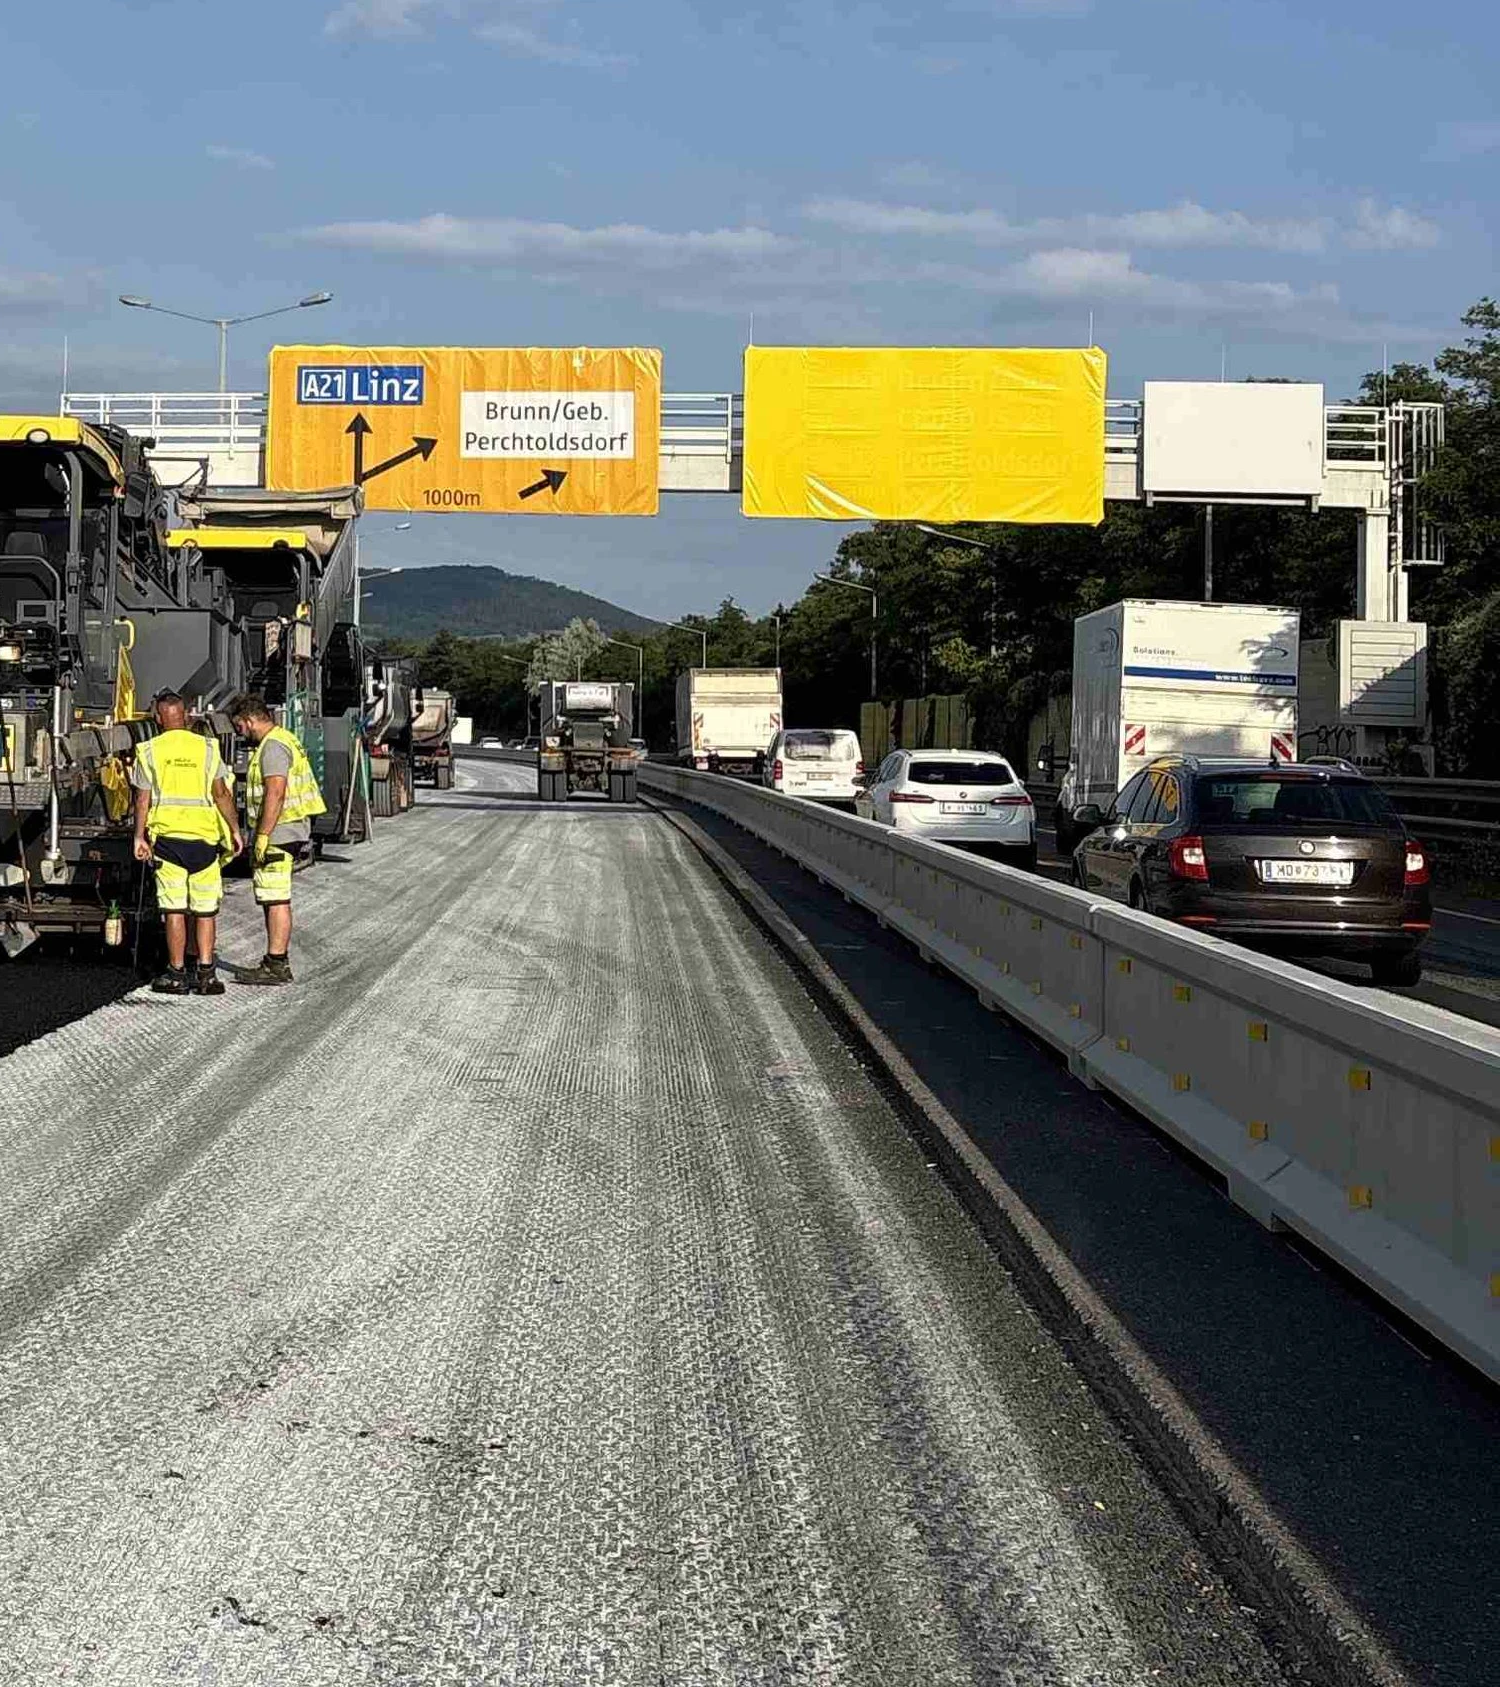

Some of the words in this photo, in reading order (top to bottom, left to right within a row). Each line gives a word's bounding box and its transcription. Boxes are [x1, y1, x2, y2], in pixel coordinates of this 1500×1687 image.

[305, 374, 342, 397] A21
[352, 370, 420, 401] Linz
[486, 399, 609, 422] Brunn/Geb.
[465, 432, 629, 451] Perchtoldsdorf
[423, 489, 481, 506] 1000m
